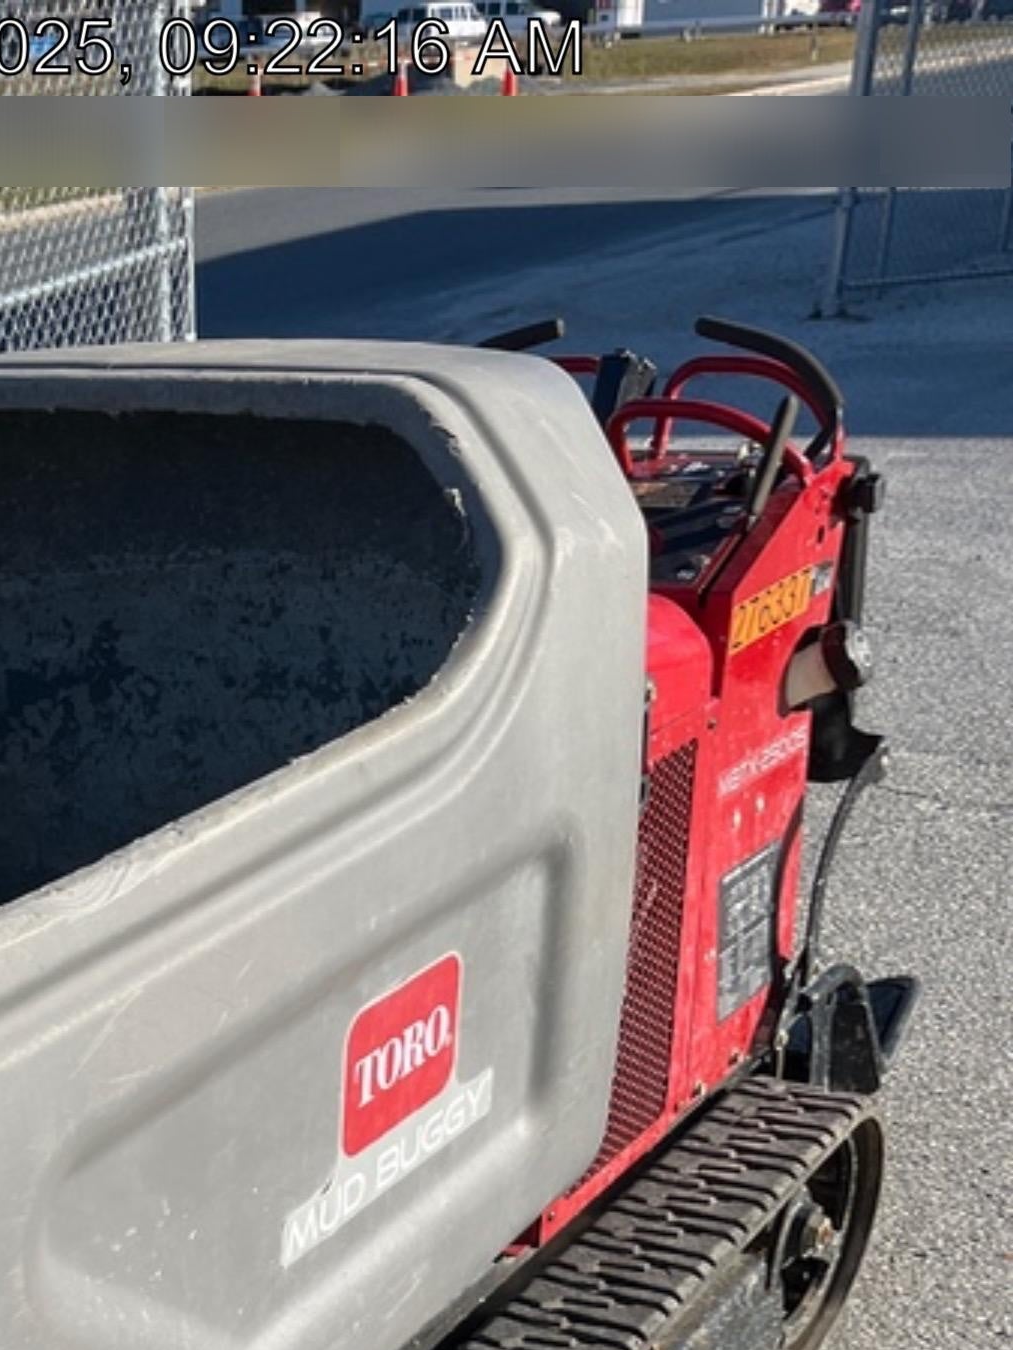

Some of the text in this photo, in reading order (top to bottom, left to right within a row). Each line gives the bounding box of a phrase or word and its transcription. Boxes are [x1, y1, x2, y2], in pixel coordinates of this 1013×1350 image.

[354, 1004, 452, 1109] TORO
[284, 1076, 490, 1262] MUD BUGGY
